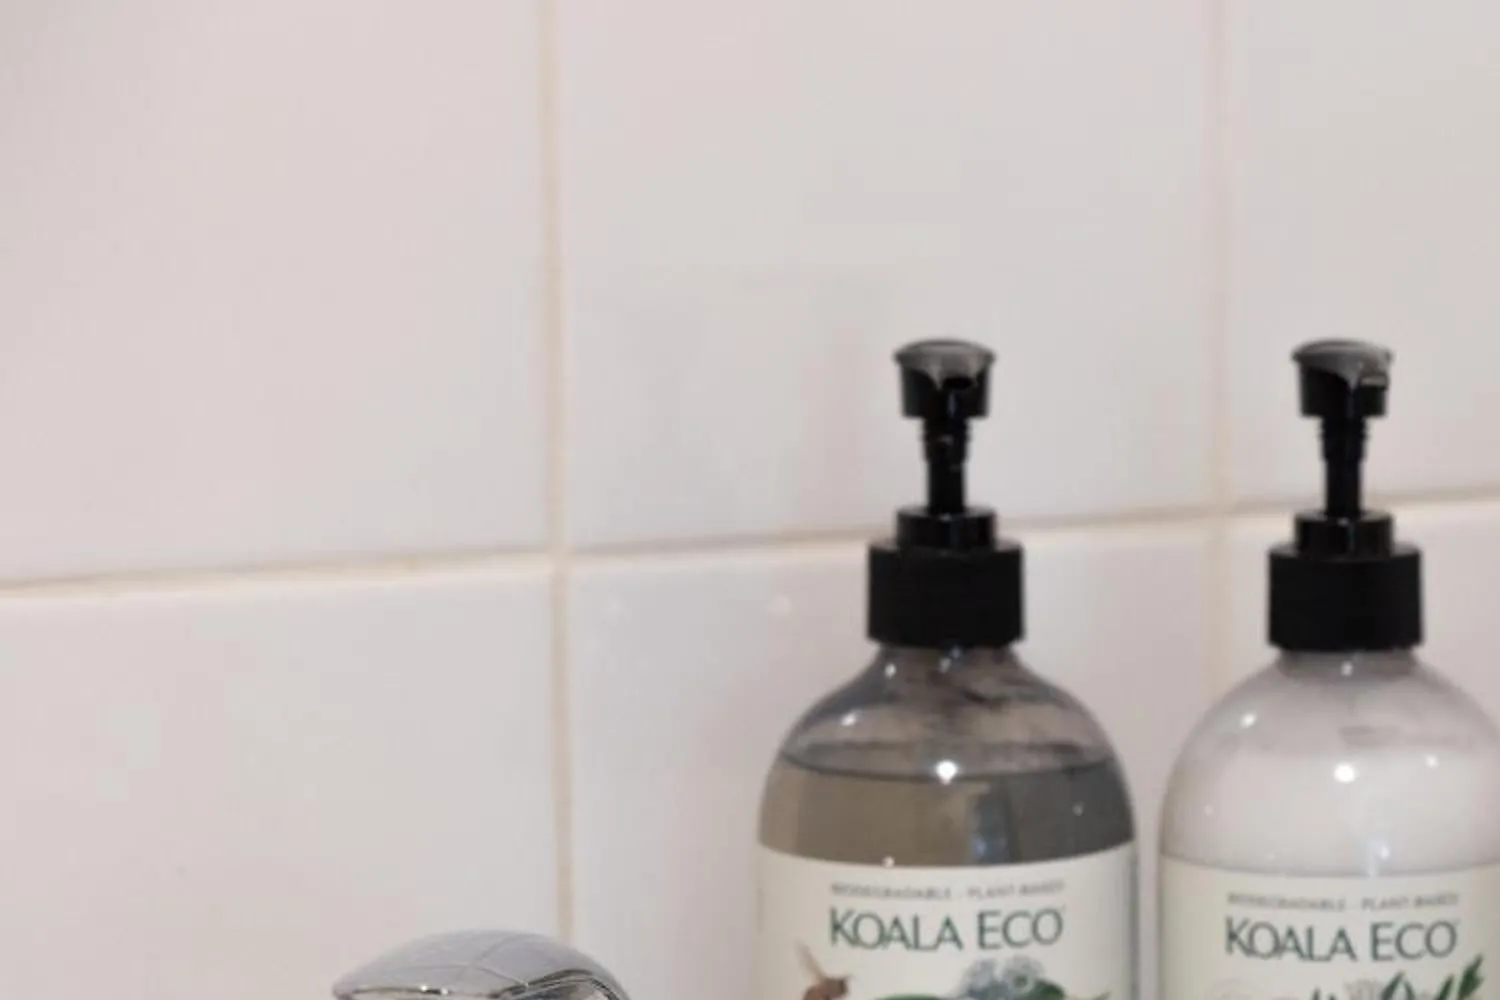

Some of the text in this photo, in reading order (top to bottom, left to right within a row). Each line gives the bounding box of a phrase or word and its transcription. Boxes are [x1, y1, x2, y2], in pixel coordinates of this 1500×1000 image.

[829, 905, 1064, 951] KOALA ECO
[1225, 916, 1458, 962] KOALA ECO
